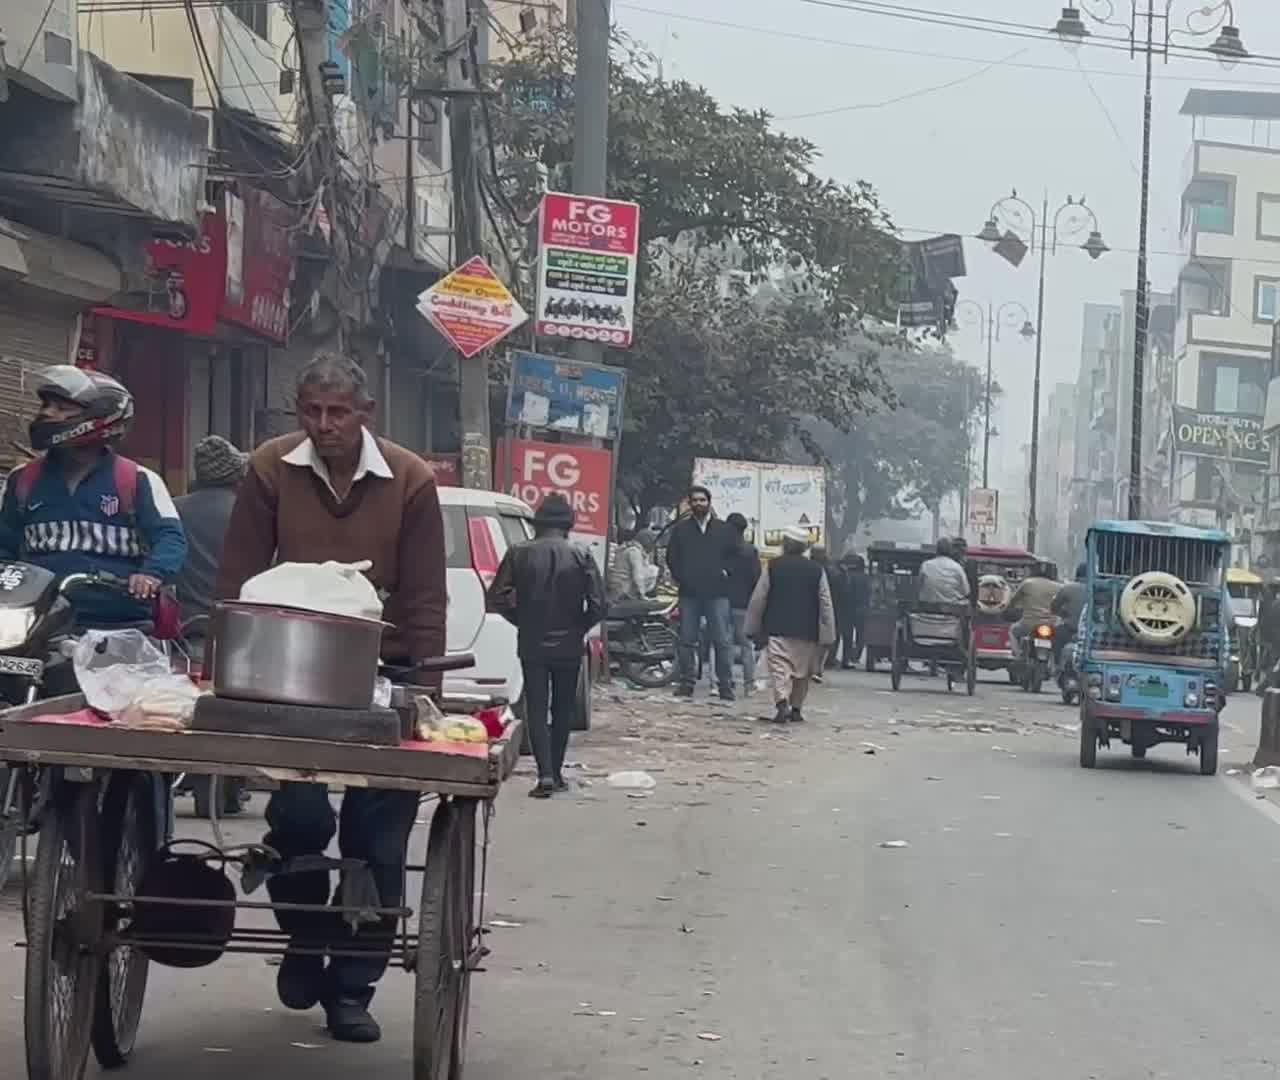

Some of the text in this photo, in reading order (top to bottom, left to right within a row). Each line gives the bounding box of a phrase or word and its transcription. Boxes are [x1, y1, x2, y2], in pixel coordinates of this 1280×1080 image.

[569, 201, 611, 224] FG
[552, 218, 628, 240] MOTORS
[524, 450, 580, 487] FG
